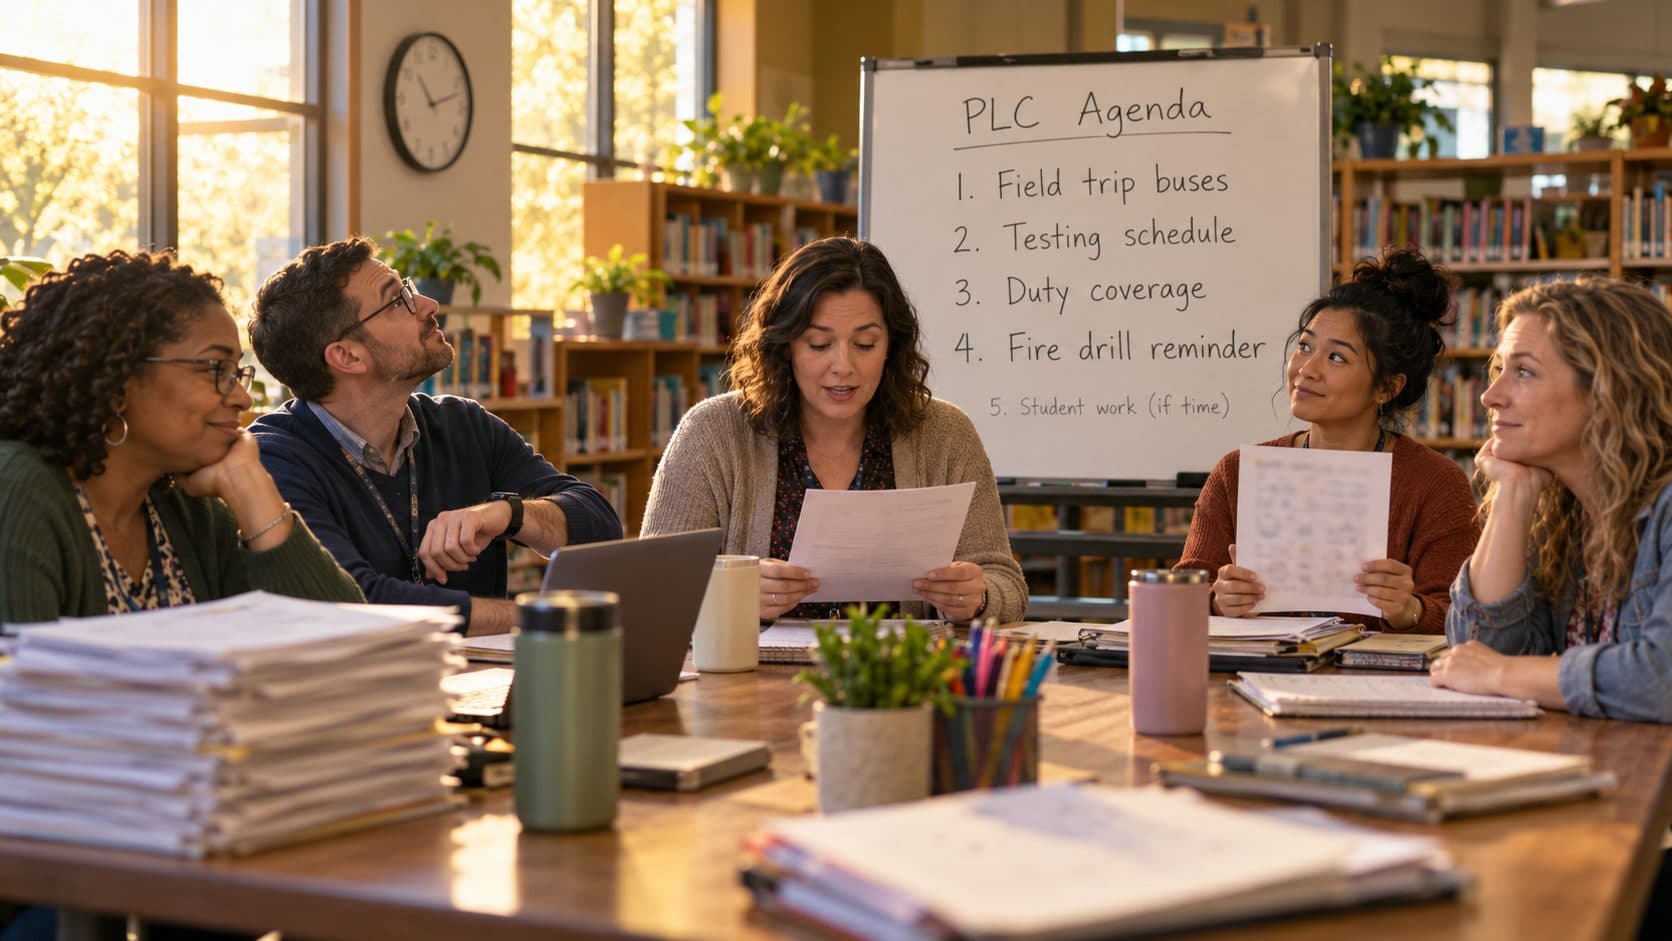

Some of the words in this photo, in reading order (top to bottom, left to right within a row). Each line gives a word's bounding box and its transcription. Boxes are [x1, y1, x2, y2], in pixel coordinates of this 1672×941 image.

[963, 96, 1040, 134] PLC
[1078, 88, 1212, 138] Agenda
[957, 172, 974, 201] 1.
[998, 168, 1062, 200] Field
[1082, 168, 1136, 205] trip
[1155, 163, 1229, 194] buses
[953, 226, 980, 253] 2.
[1002, 222, 1101, 261] Testing
[1124, 216, 1236, 246] schedule
[955, 279, 981, 306] 3.
[1007, 276, 1069, 315] Duty
[1090, 281, 1207, 312] coverage
[954, 332, 983, 363] 4.
[1008, 331, 1062, 363] Fire
[1079, 330, 1132, 361] drill
[1151, 329, 1266, 361] reminder
[990, 397, 1007, 417] 5.
[1020, 396, 1085, 417] Student
[1096, 396, 1137, 416] work
[1148, 392, 1172, 419] (if
[1180, 392, 1230, 420] time)
